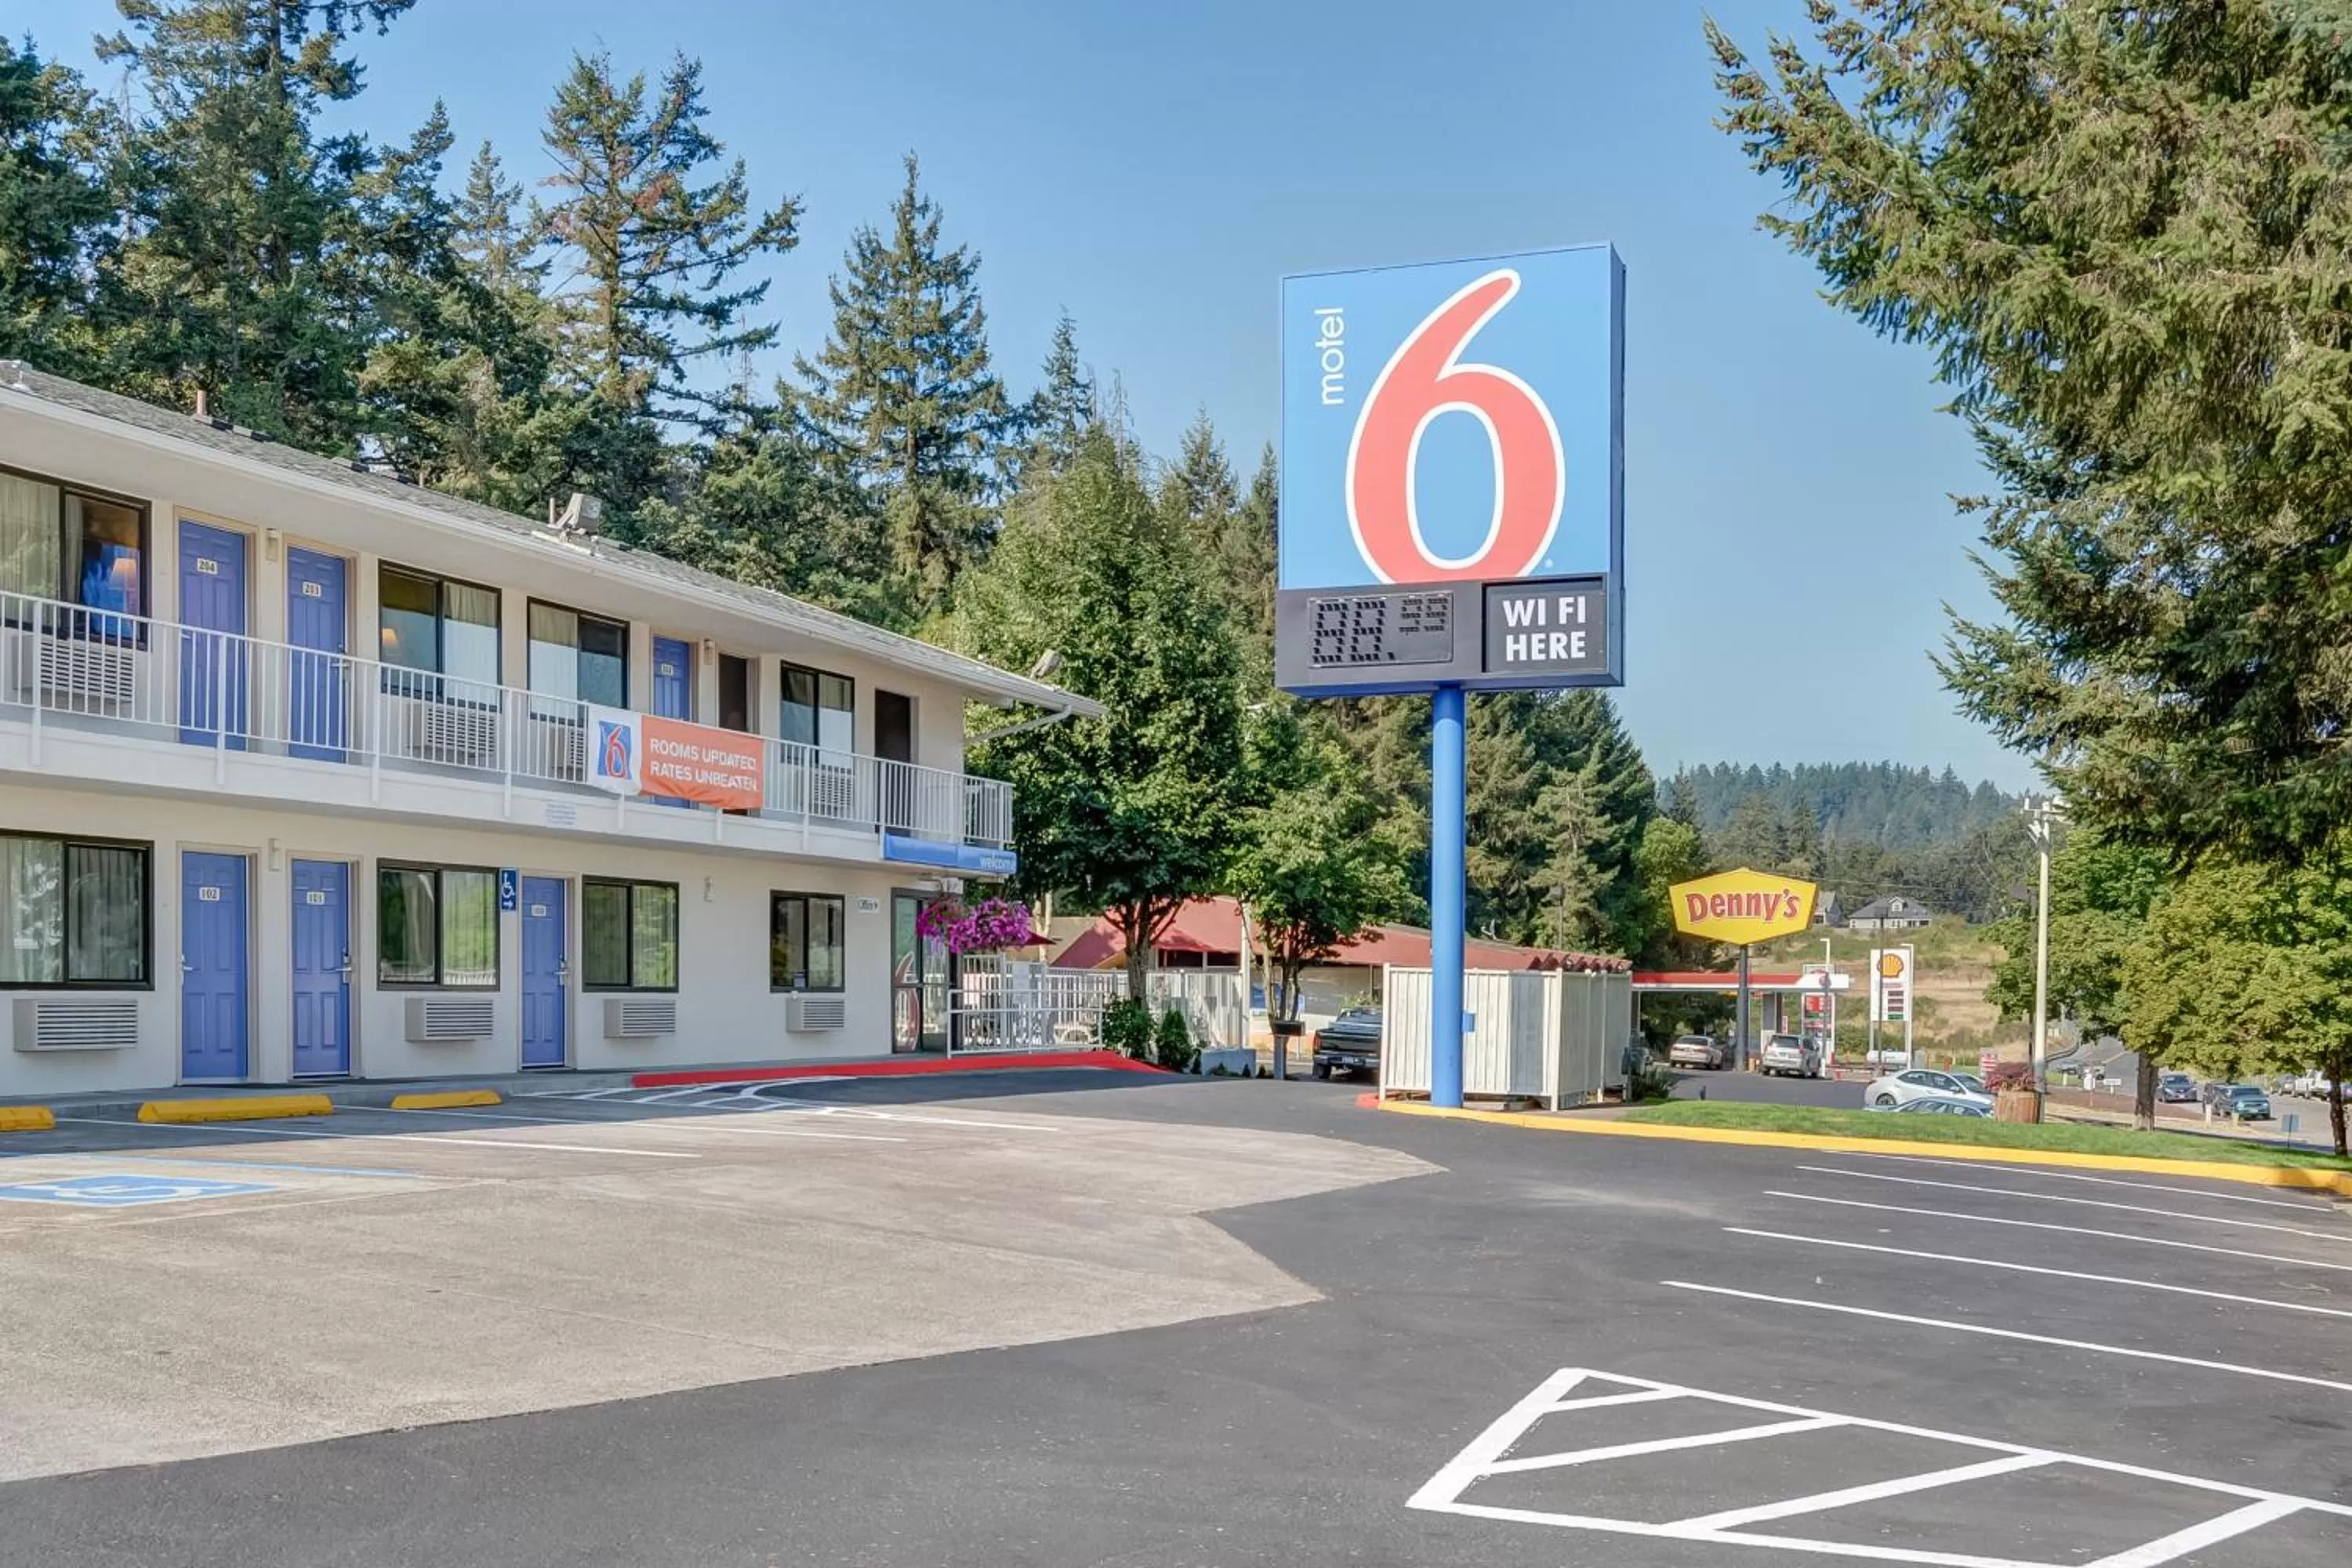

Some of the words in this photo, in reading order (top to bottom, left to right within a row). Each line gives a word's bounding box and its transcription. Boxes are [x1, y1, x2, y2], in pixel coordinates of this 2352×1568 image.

[1314, 308, 1345, 405] motel
[1345, 268, 1566, 585] 6
[1503, 599, 1546, 626] WI
[1559, 596, 1586, 624] FI
[1506, 631, 1586, 661] HERE
[605, 727, 627, 779] 6
[649, 738, 699, 760] ROOMS
[650, 761, 692, 781] RATES
[201, 888, 217, 899] 102
[1685, 888, 1801, 923] Denny's
